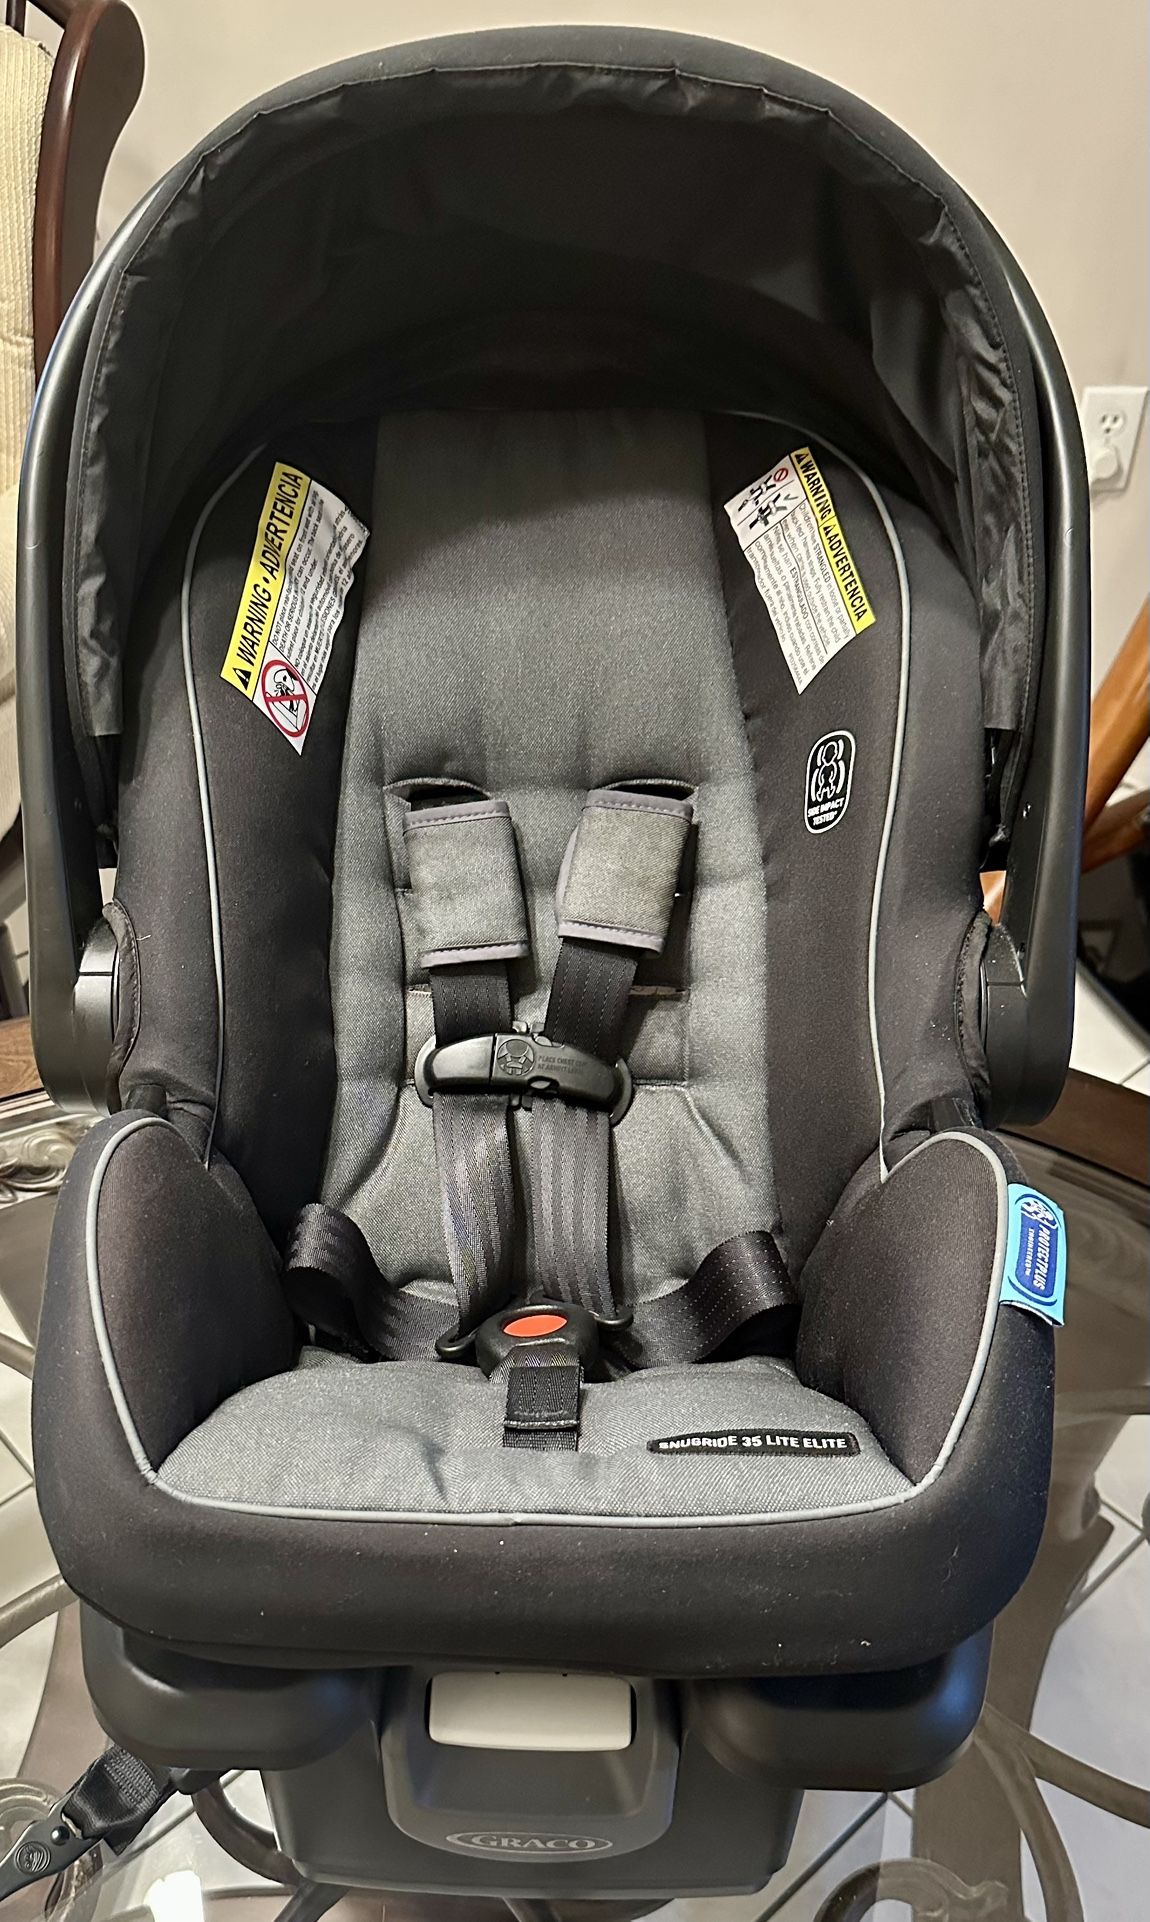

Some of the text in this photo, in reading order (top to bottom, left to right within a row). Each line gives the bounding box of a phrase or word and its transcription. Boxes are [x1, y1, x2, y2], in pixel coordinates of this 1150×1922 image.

[800, 461, 831, 521] WARNING
[237, 471, 303, 667] WARNING ADVERTENCIA
[826, 533, 867, 622] ADVERTENCIA
[820, 797, 845, 813] IMPACT
[1033, 1224, 1050, 1291] PROTECTPLUS
[659, 1434, 848, 1449] SNUGRIDE 35 LITE ELITE
[471, 1835, 596, 1849] GRACO
